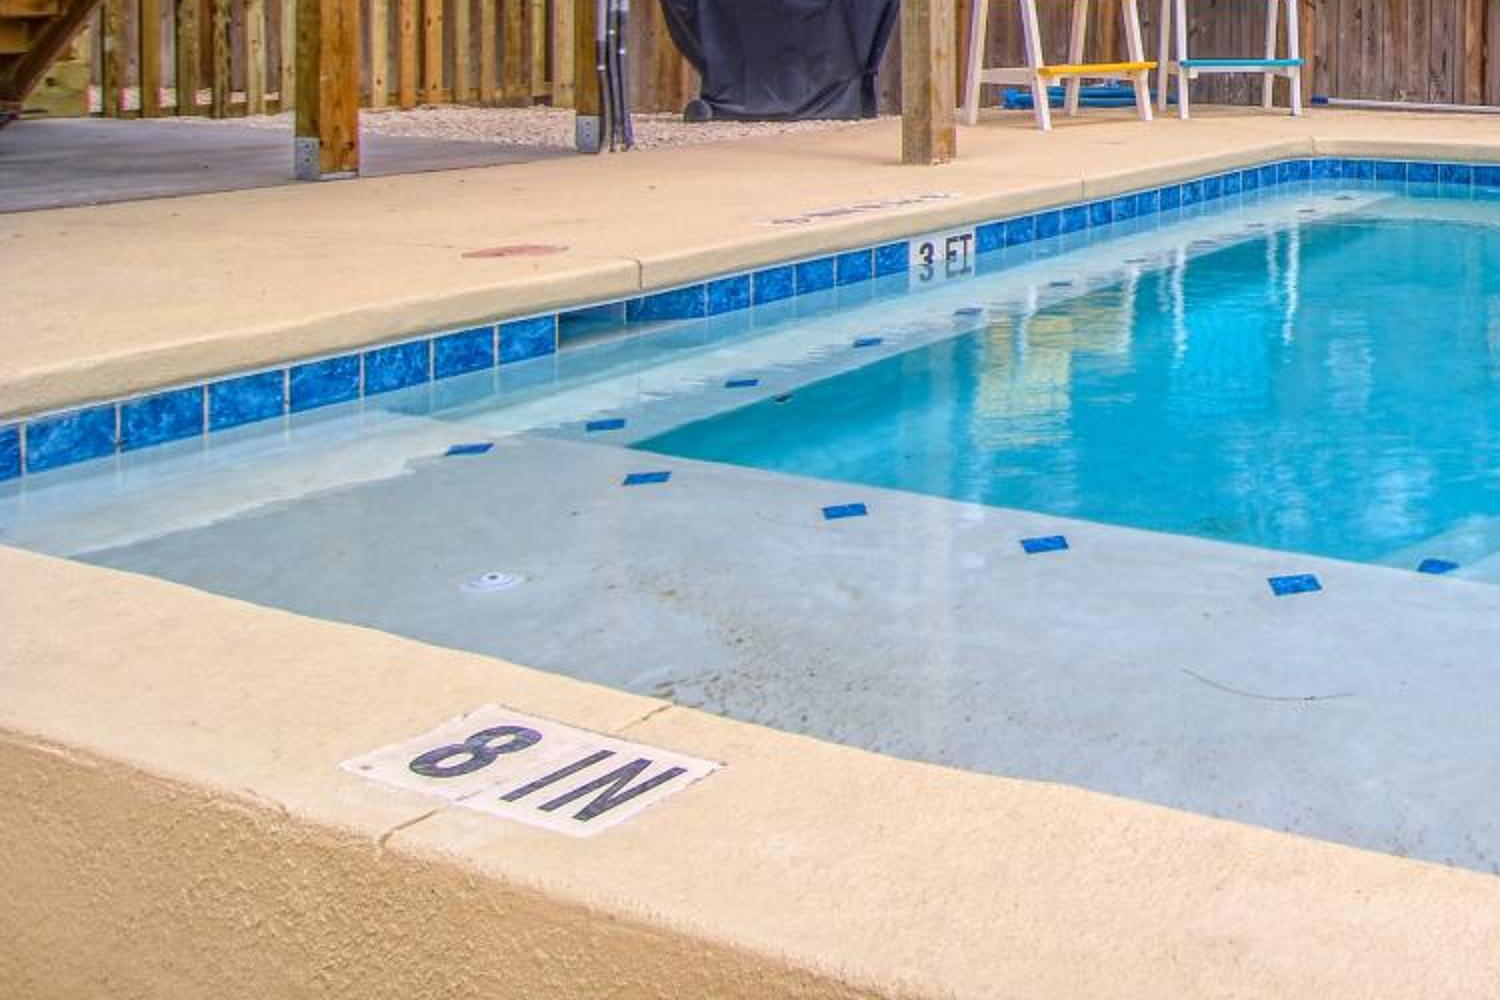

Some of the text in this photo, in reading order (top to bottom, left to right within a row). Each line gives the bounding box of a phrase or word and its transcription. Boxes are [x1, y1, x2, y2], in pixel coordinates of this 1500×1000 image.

[920, 233, 973, 268] 3 FT
[409, 725, 688, 822] 8 IN
